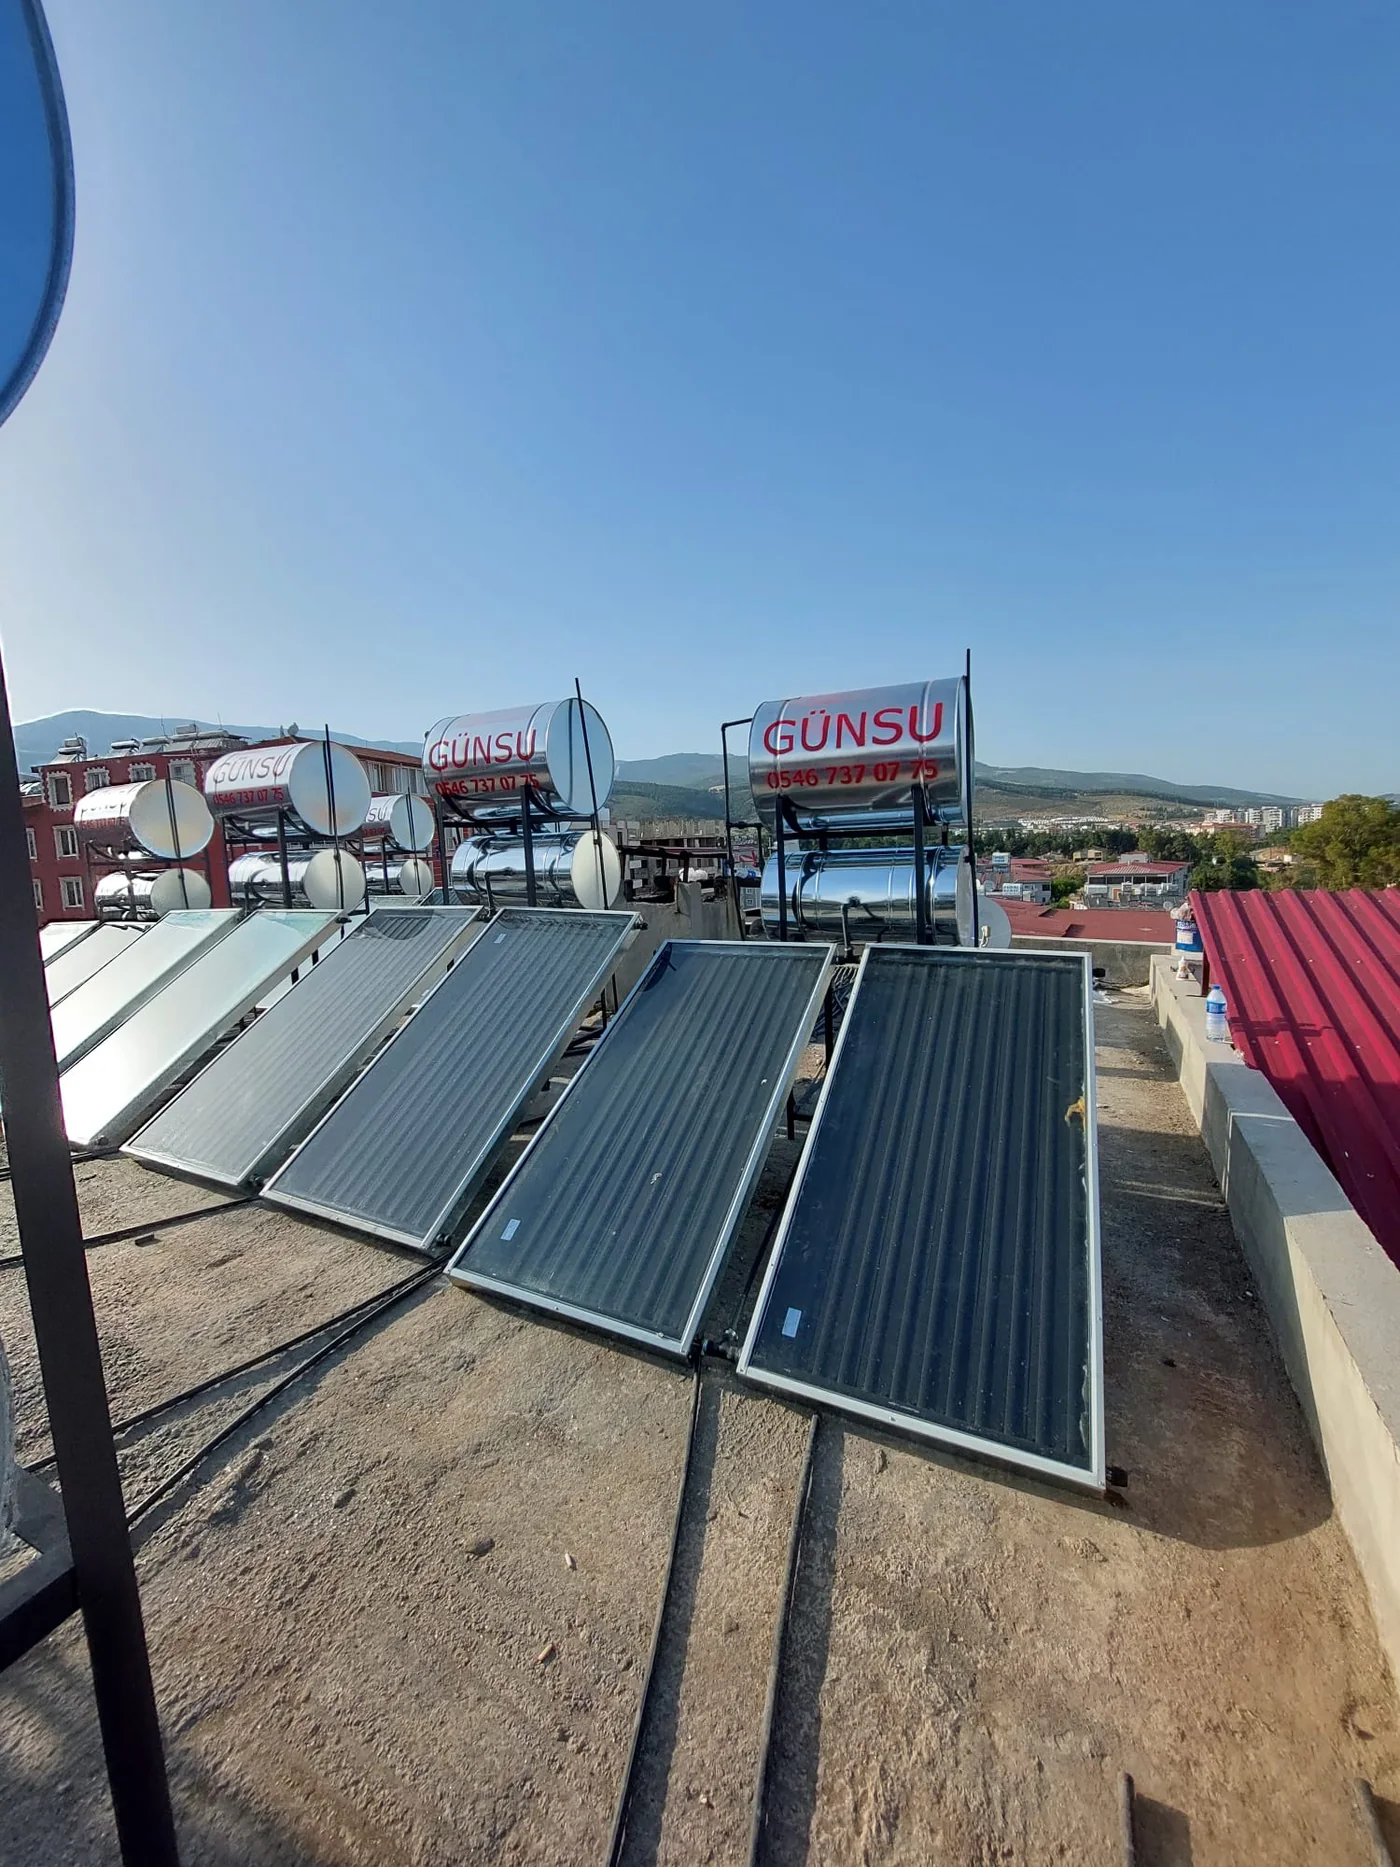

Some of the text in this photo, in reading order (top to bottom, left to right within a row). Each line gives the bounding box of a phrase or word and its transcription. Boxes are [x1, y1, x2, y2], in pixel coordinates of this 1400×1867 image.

[763, 702, 943, 756] GÜNSU
[428, 728, 537, 772] GÜNSU
[434, 773, 540, 797] 0546 737 07 75
[767, 759, 939, 789] 0546 737 07 75
